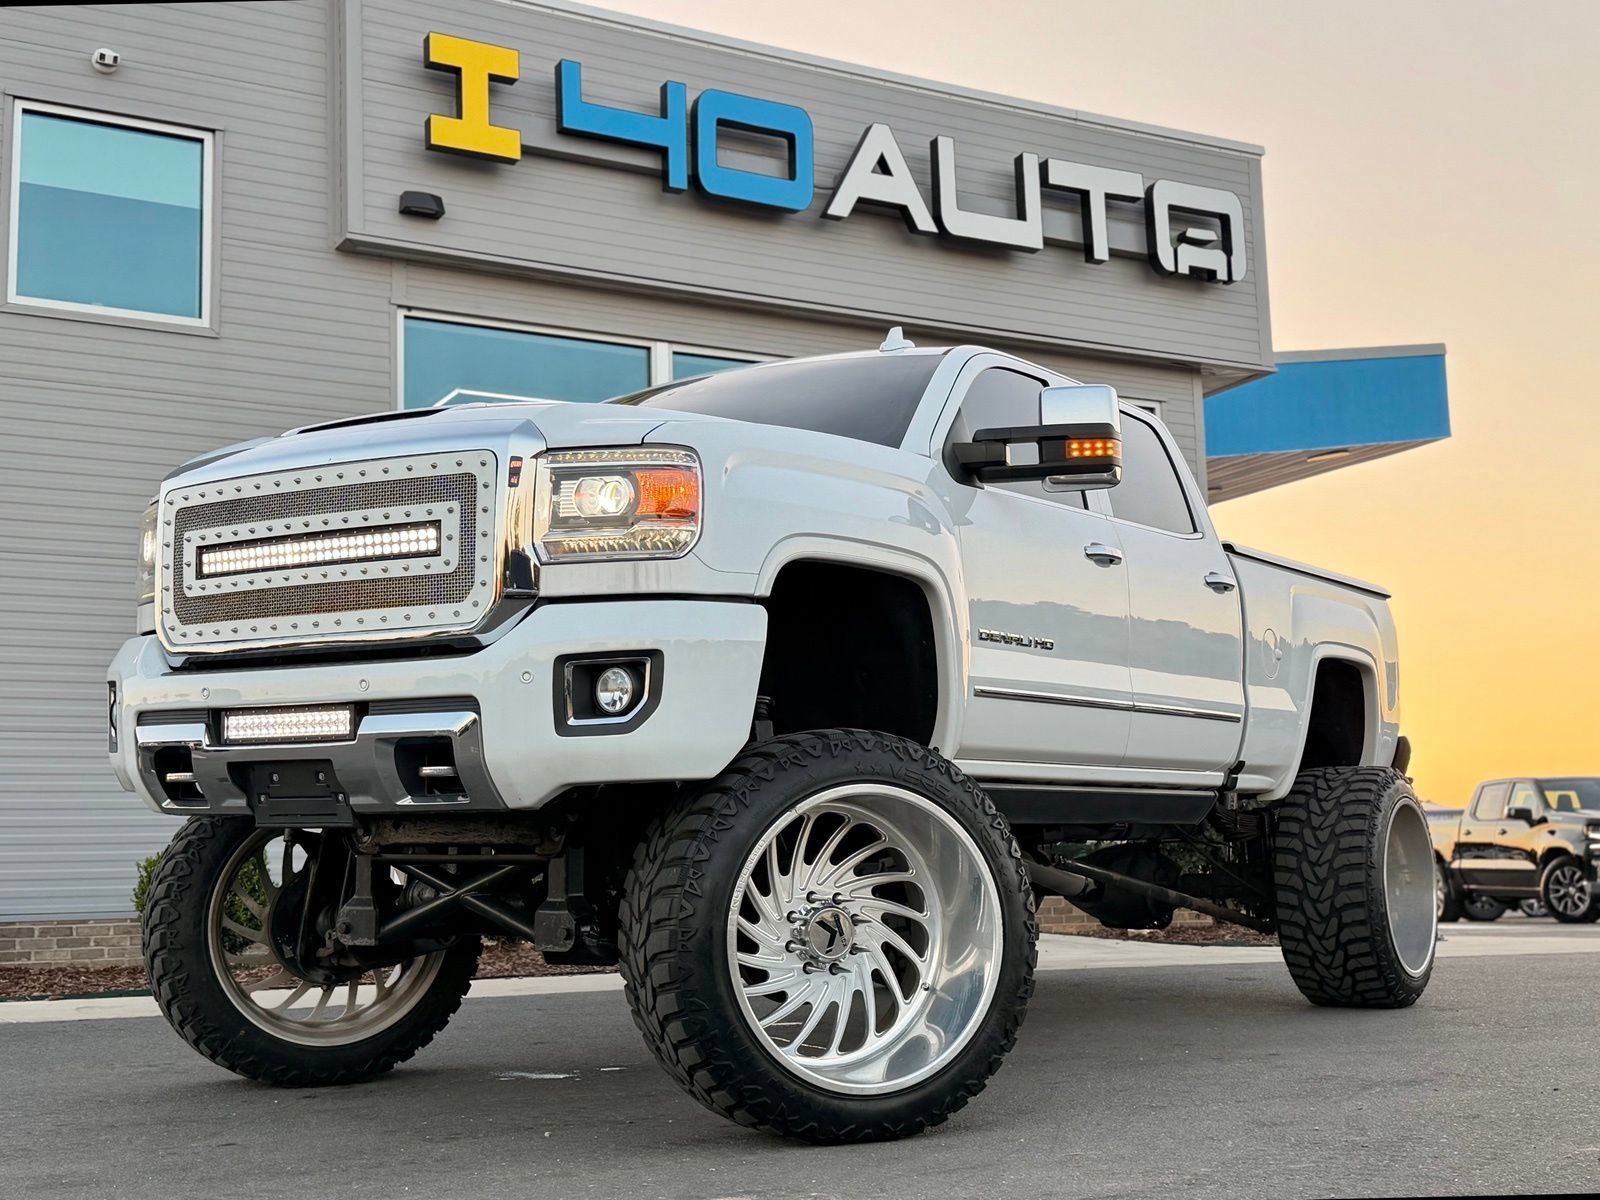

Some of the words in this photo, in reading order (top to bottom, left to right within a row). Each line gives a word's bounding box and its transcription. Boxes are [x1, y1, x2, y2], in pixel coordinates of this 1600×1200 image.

[821, 122, 1248, 284] AUTO
[978, 627, 1032, 648] DENALI
[1033, 636, 1055, 650] HD
